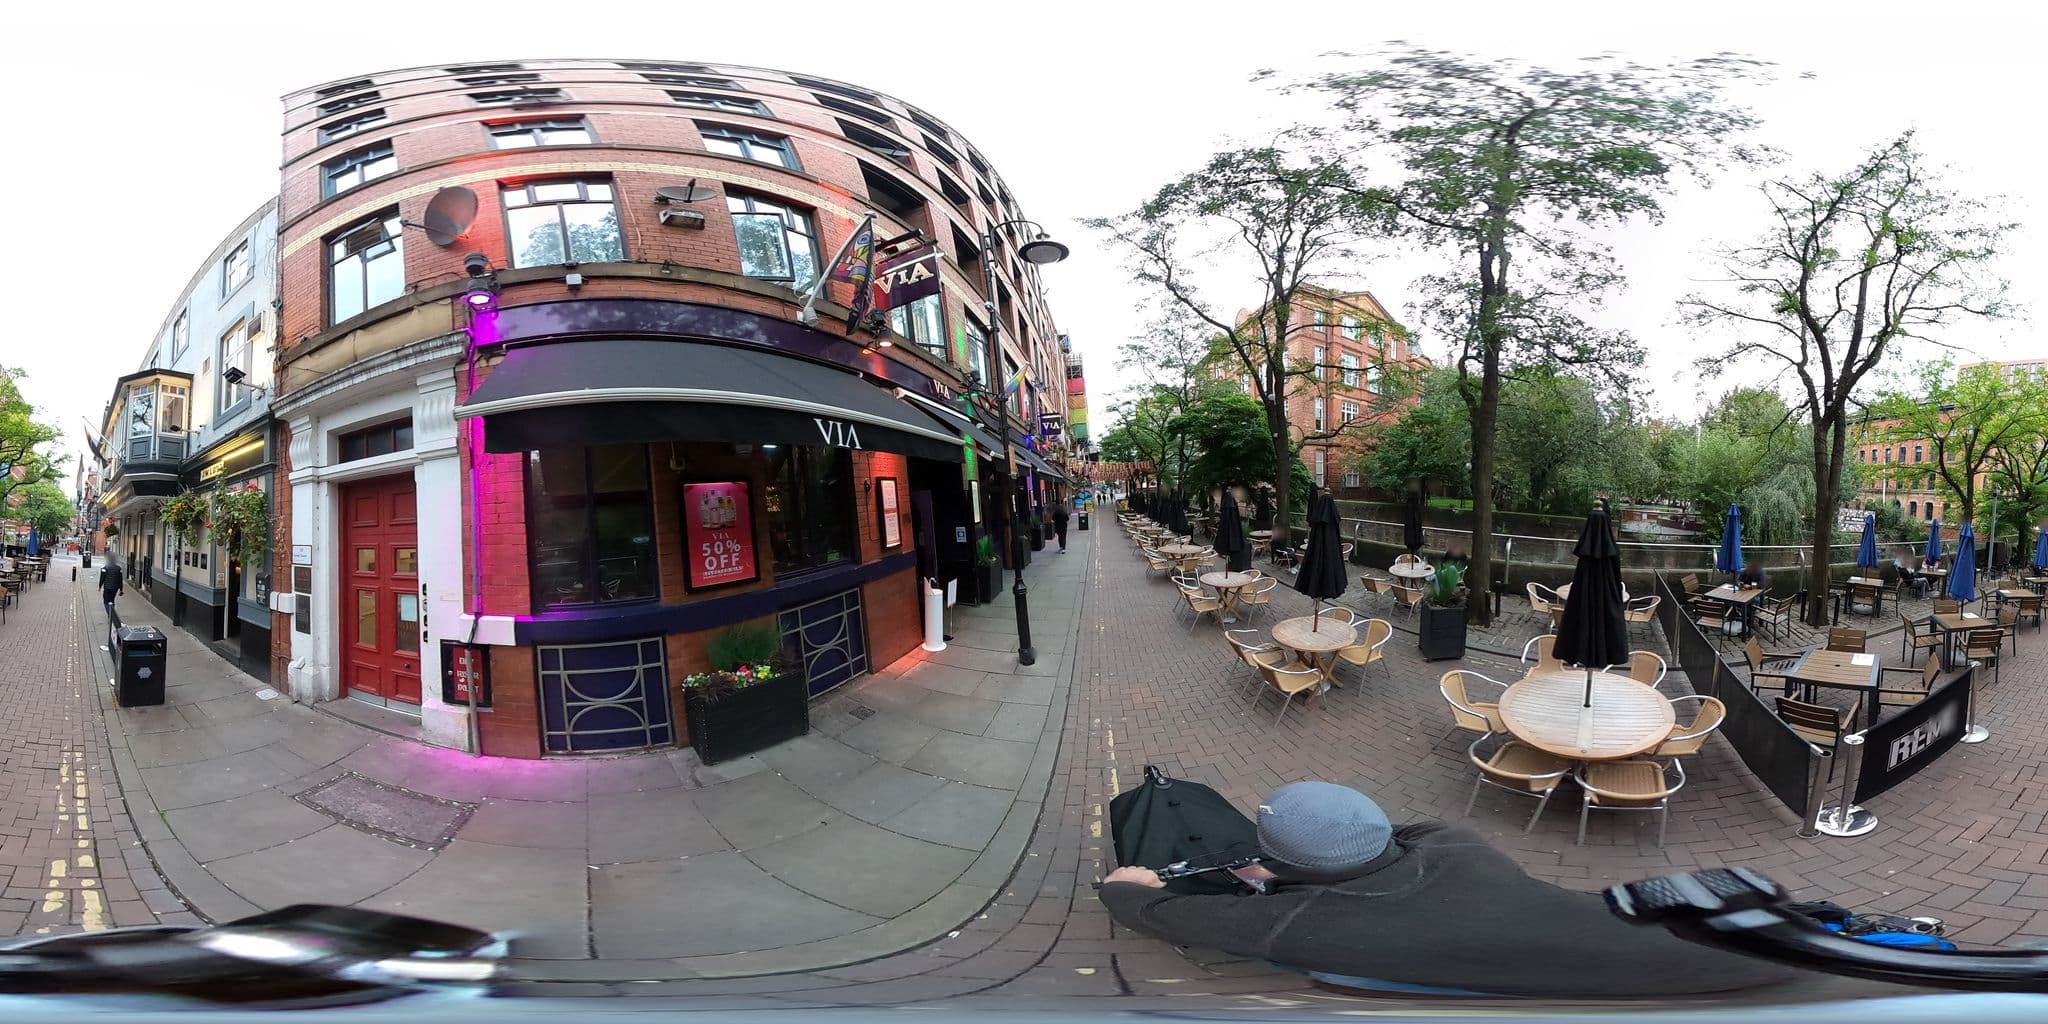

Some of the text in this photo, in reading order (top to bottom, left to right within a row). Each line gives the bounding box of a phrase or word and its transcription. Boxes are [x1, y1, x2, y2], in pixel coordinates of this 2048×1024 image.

[874, 262, 934, 295] VIA
[933, 379, 951, 400] VIA
[813, 418, 863, 450] VIA
[1042, 421, 1060, 431] VIA
[712, 532, 730, 540] VIA
[702, 539, 741, 557] 50%
[704, 552, 741, 570] OFF
[456, 670, 480, 680] RISR
[457, 684, 480, 694] INLT
